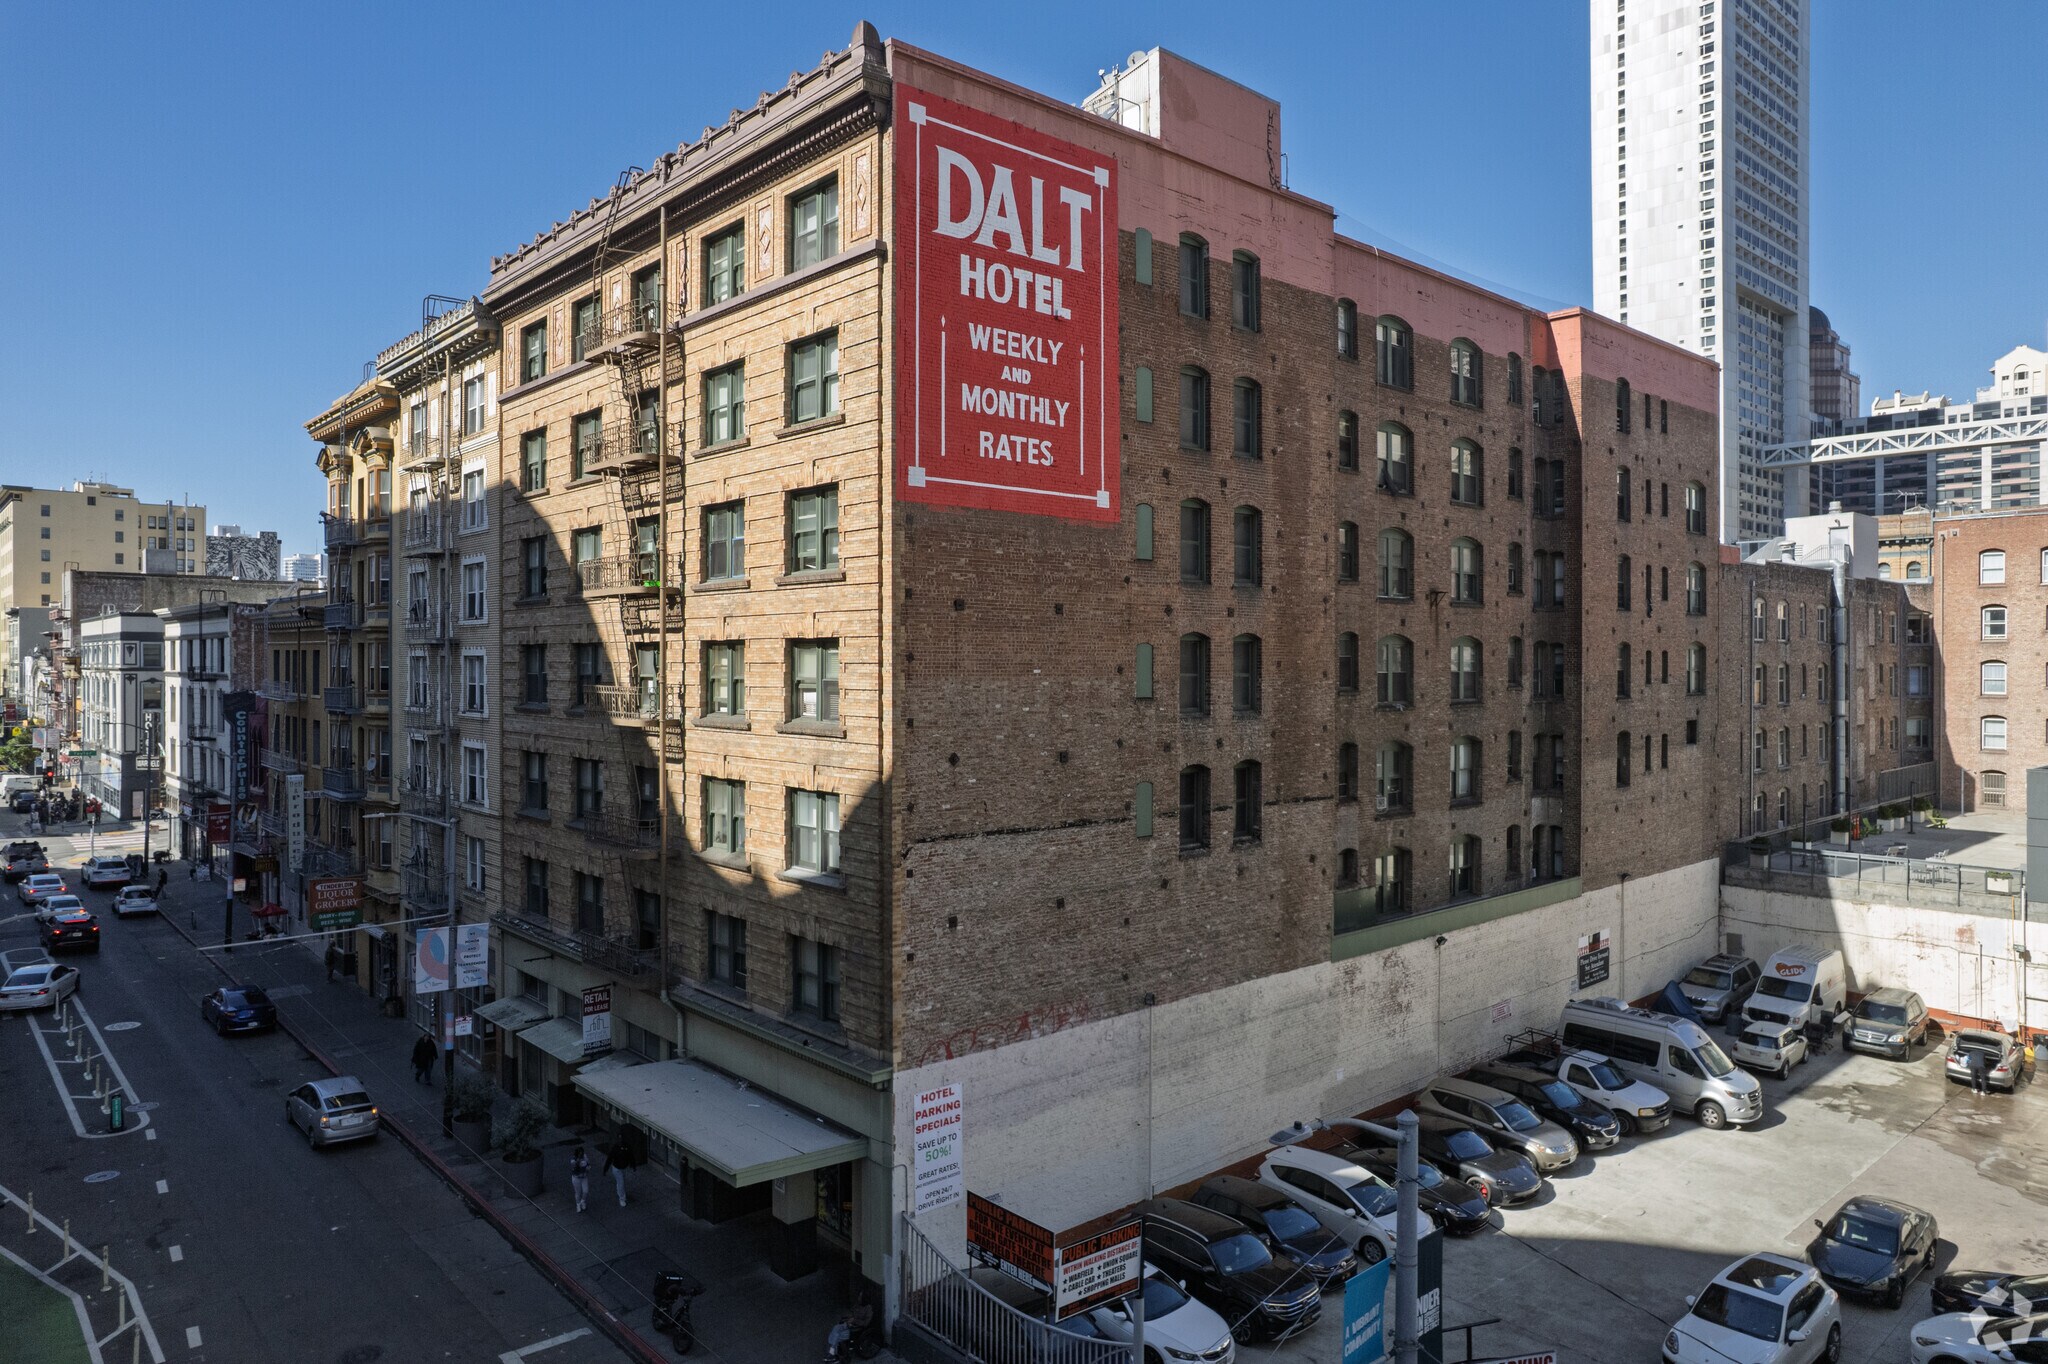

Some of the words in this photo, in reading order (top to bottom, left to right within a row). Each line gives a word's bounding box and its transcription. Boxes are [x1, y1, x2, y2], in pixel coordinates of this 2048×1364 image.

[932, 144, 1092, 273] DALT
[960, 253, 1072, 320] HOTEL
[968, 322, 1064, 366] WEEKLY
[1001, 365, 1032, 385] AND
[961, 382, 1070, 428] MONTHLY
[979, 430, 1054, 467] RATES
[318, 888, 354, 900] LIQUOR
[320, 882, 354, 890] TENDERLOIN
[315, 898, 358, 910] GROCERY
[1780, 967, 1804, 976] GLIDE
[584, 992, 609, 1004] RETAIL
[594, 1002, 609, 1011] LEASE
[921, 1088, 955, 1104] HOTEL
[915, 1100, 961, 1120] PARKING
[915, 1113, 961, 1135] SPECIALS
[917, 1138, 936, 1152] SAVE
[936, 1135, 947, 1145] UP
[947, 1132, 957, 1142] TO
[925, 1144, 952, 1162] 50%!
[918, 1168, 938, 1181] GREAT
[938, 1162, 959, 1175] RATES!
[918, 1199, 935, 1211] DRIVE
[935, 1194, 953, 1205] RIGHT
[925, 1189, 941, 1200] OPEN
[941, 1184, 953, 1195] 24/7
[969, 1193, 1004, 1221] PUBLIC
[1006, 1212, 1052, 1245] PARKING
[974, 1210, 989, 1226] FOR
[990, 1217, 1004, 1232] THE
[1005, 1225, 1033, 1249] EVENTS
[1035, 1240, 1045, 1254] AT
[1062, 1239, 1098, 1264] PUBLIC
[1100, 1222, 1140, 1250] PARKING
[969, 1219, 996, 1241] GOLDEN
[998, 1234, 1016, 1253] GATE
[1018, 1243, 1051, 1270] THEATRE
[974, 1232, 1010, 1259] WARFIELD
[1012, 1252, 1045, 1279] THEATRE
[1063, 1262, 1083, 1275] WITHIN
[1083, 1253, 1106, 1268] WALKING
[1106, 1244, 1131, 1260] DISTANCE
[1068, 1267, 1094, 1283] WARFIELD
[1102, 1257, 1118, 1269] UNION
[1119, 1249, 1138, 1264] SQUARE
[1001, 1260, 1018, 1276] ENTER
[1018, 1268, 1034, 1284] HERE
[1068, 1280, 1084, 1292] CABLE
[1084, 1275, 1096, 1286] CAR
[1102, 1263, 1126, 1278] THEATERS
[1083, 1277, 1109, 1295] SHOPPING
[1109, 1271, 1126, 1284] MALLS
[1345, 1326, 1350, 1340] A
[1352, 1302, 1381, 1335] VIBRANT
[1344, 1318, 1381, 1357] COMMUNITY
